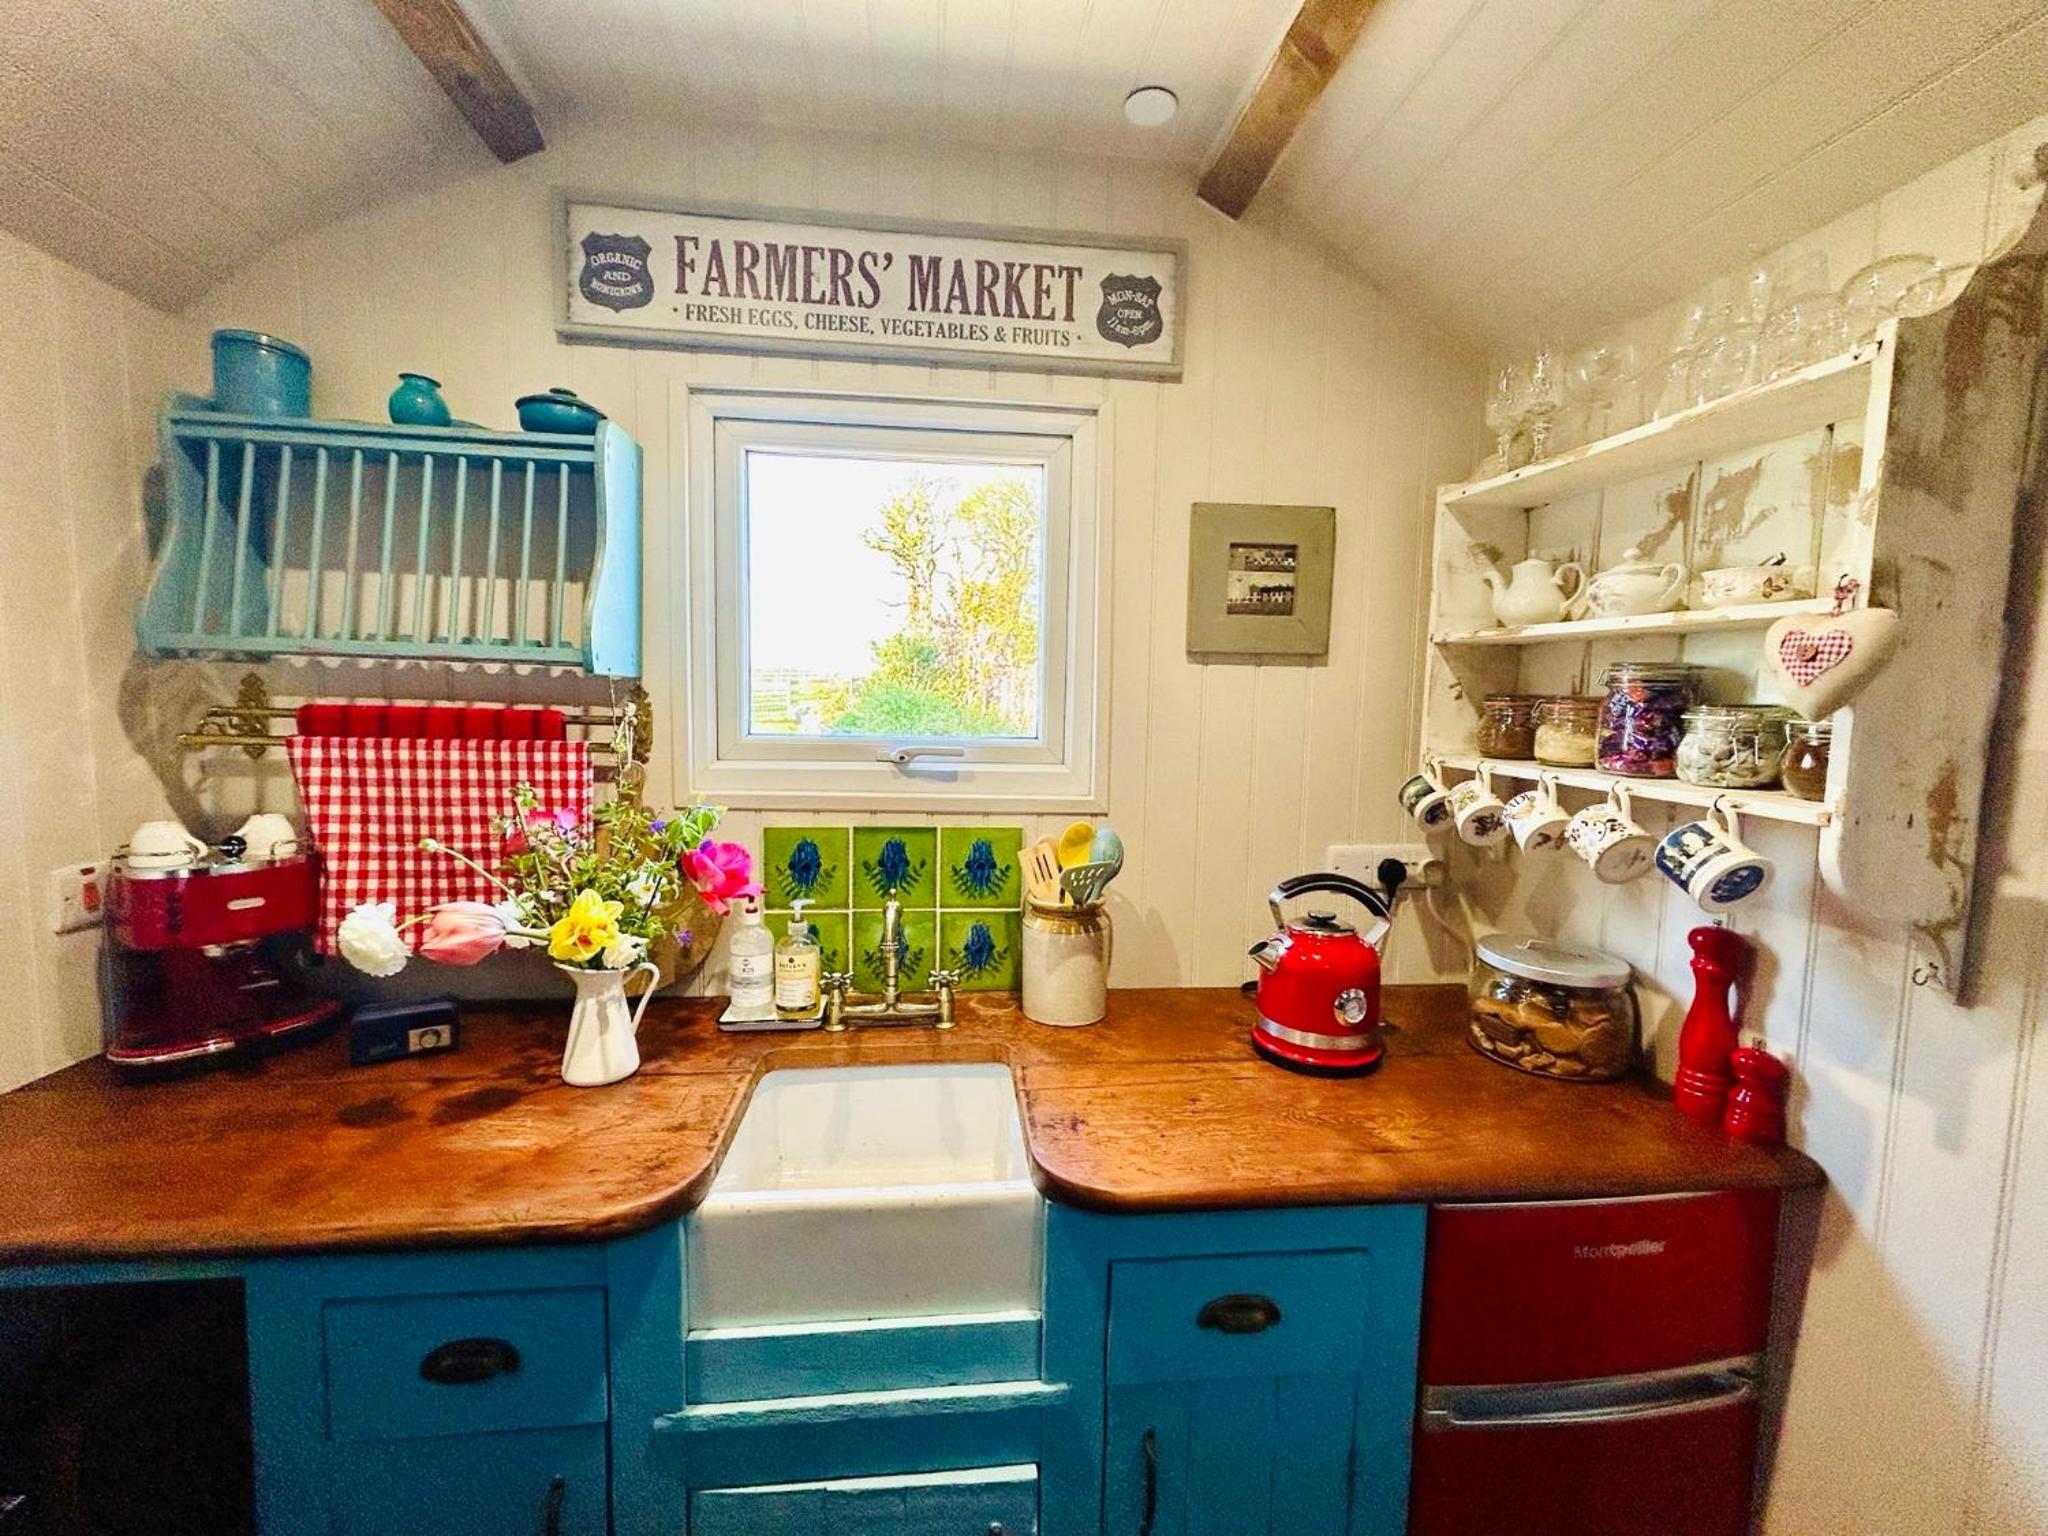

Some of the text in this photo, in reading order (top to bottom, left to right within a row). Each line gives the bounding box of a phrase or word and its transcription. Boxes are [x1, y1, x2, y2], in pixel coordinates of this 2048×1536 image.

[590, 252, 643, 270] ORGANIC
[603, 271, 632, 281] AND
[674, 234, 1083, 322] FARMERS' MARKET
[1117, 309, 1142, 319] OPEN
[686, 304, 1070, 347] FRESH EGGS, CHEESE, VEGETABLES & FRUITS
